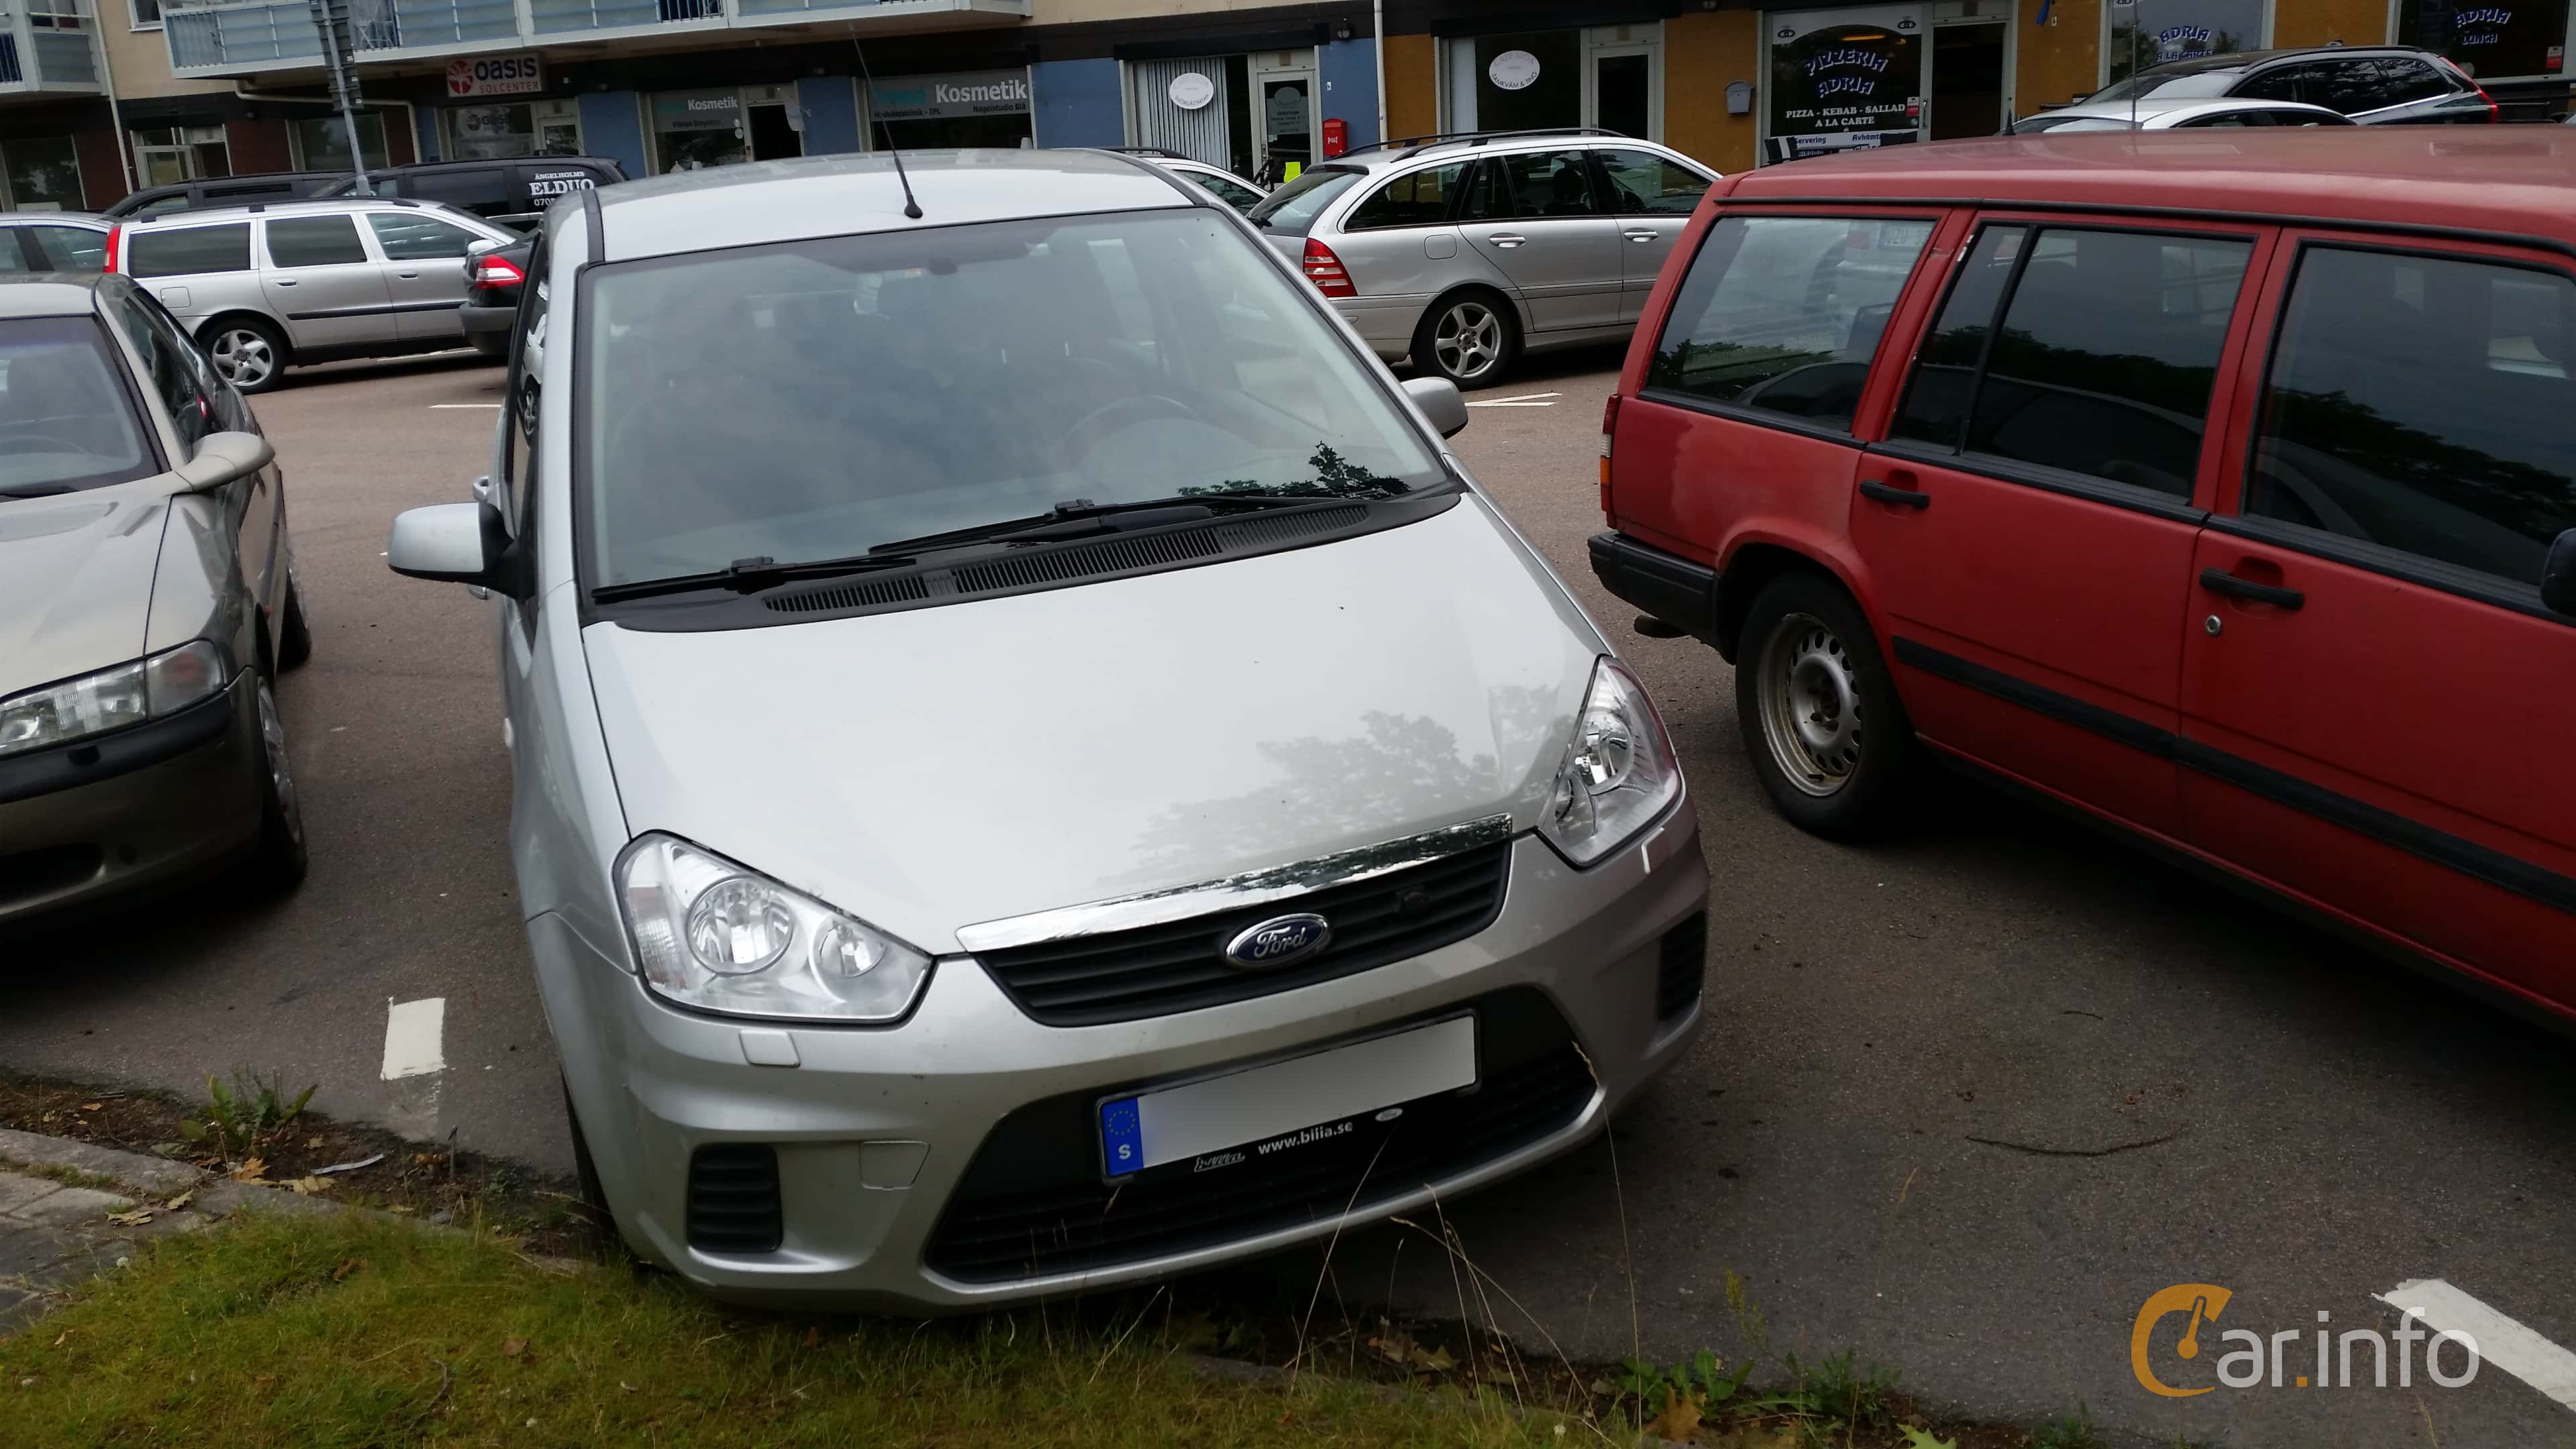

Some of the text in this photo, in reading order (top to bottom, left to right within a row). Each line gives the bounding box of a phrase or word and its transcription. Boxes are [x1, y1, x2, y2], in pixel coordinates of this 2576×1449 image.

[2455, 9, 2511, 28] ADRIA
[2159, 26, 2211, 44] ADRIA
[2461, 34, 2498, 45] LUNCH
[1804, 48, 1888, 76] PIZZERIA
[479, 81, 538, 94] SOLCENTER
[935, 79, 1027, 103] Kosmetik
[1818, 76, 1874, 99] ADRIA
[688, 97, 738, 111] Kosmetik
[1786, 109, 1814, 118] PIZZA
[1823, 107, 1857, 116] KEBAB
[1866, 104, 1905, 113] SALLAD
[1825, 118, 1838, 126] LA
[1841, 117, 1874, 125] CARTE
[1254, 926, 1306, 958] Ford
[1258, 1122, 1353, 1155] www.bilia.se
[1118, 1143, 1131, 1161] S
